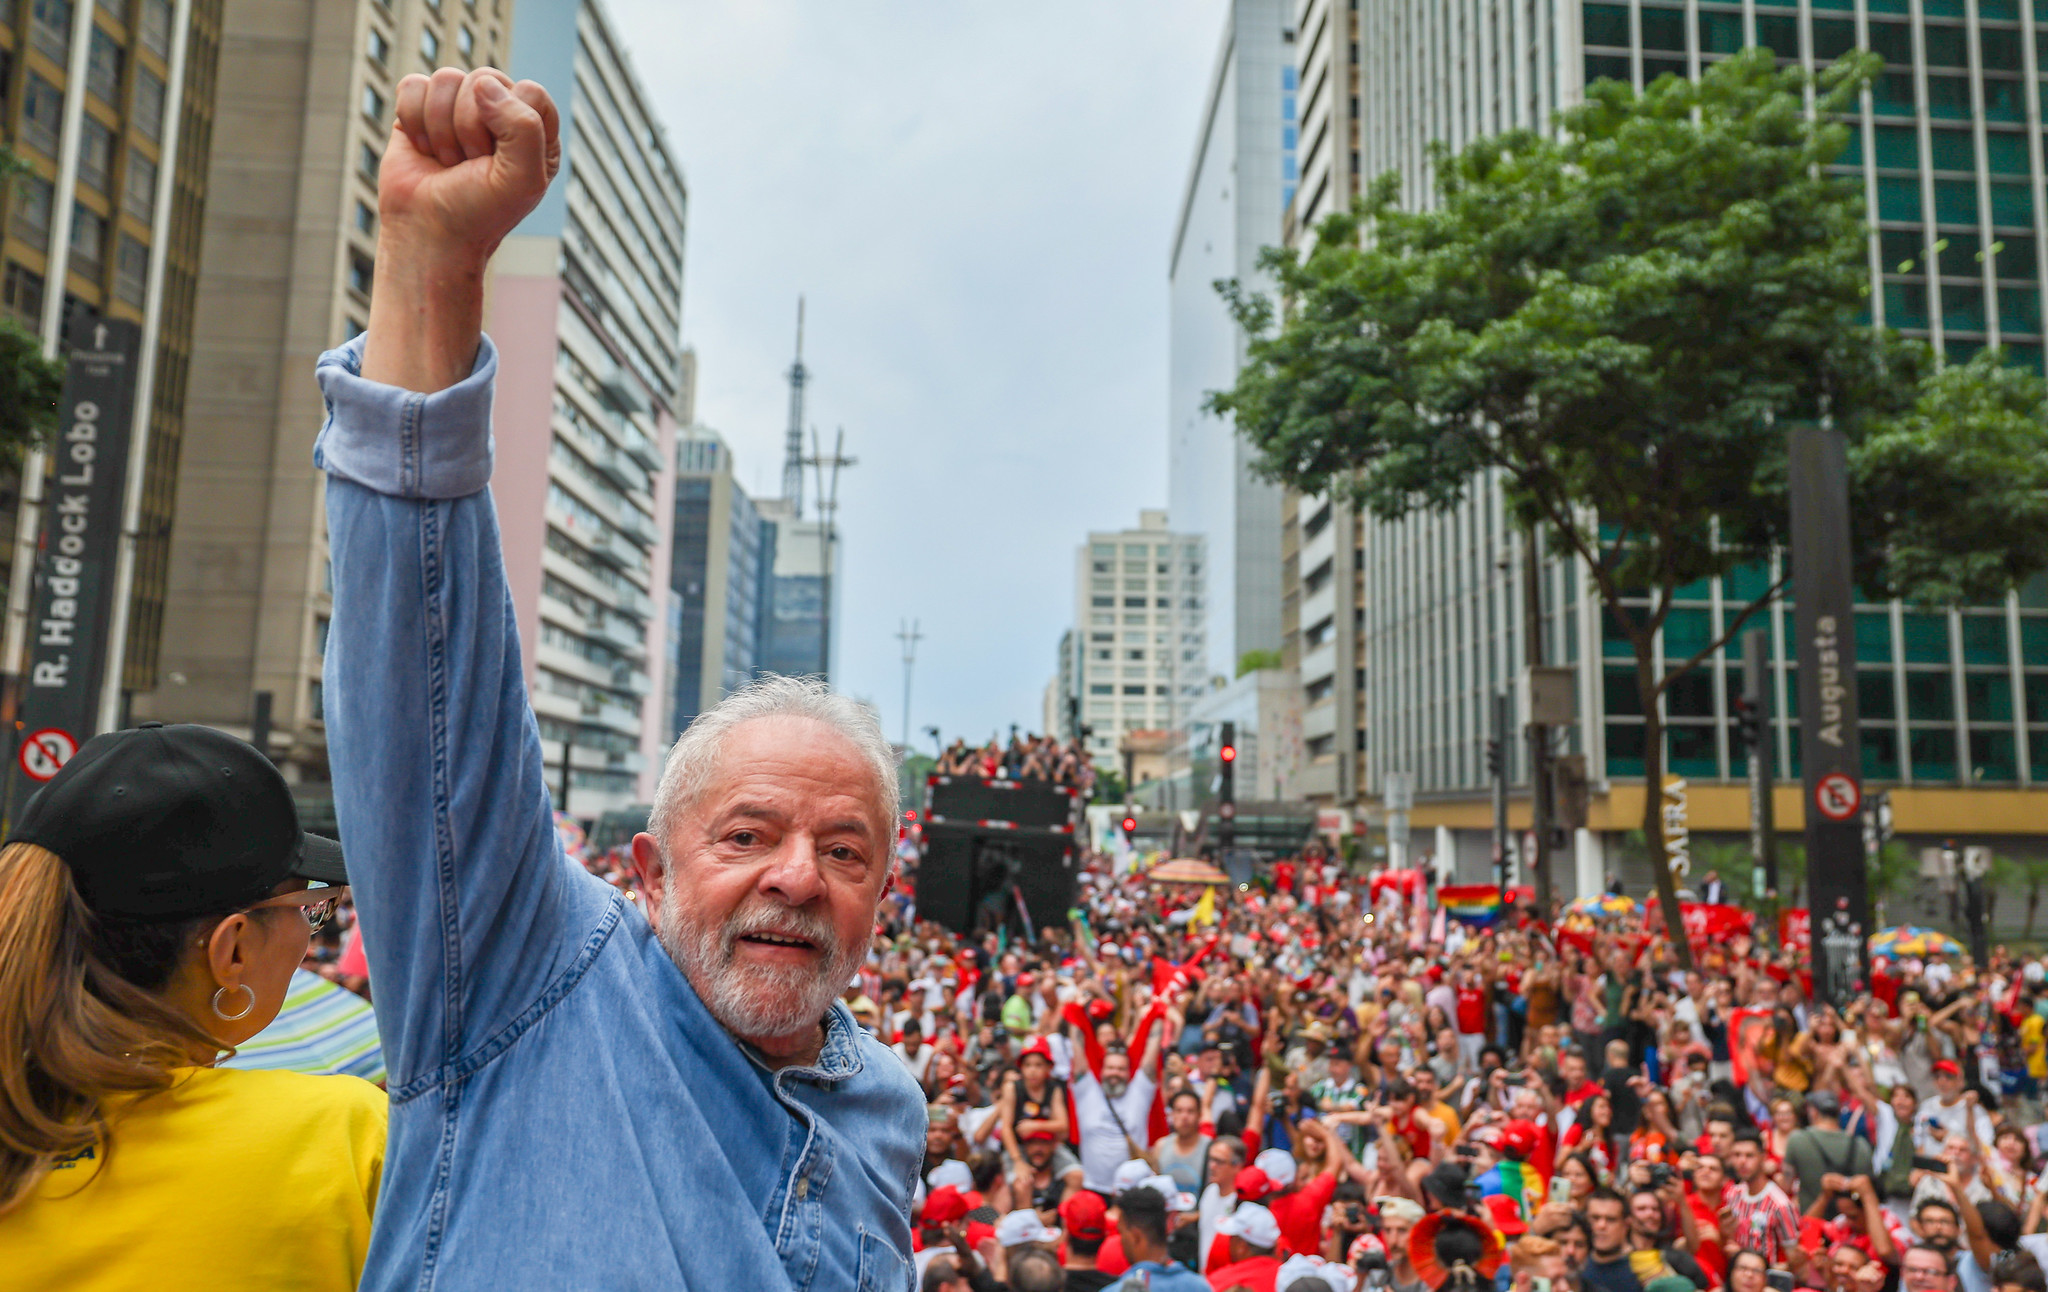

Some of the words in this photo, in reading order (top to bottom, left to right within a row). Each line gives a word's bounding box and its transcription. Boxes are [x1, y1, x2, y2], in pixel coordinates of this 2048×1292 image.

[60, 400, 100, 486] Lobo
[40, 494, 90, 646] Haddock
[33, 653, 70, 687] R.
[1813, 615, 1846, 747] Augusta
[1663, 778, 1691, 877] SAFRA
